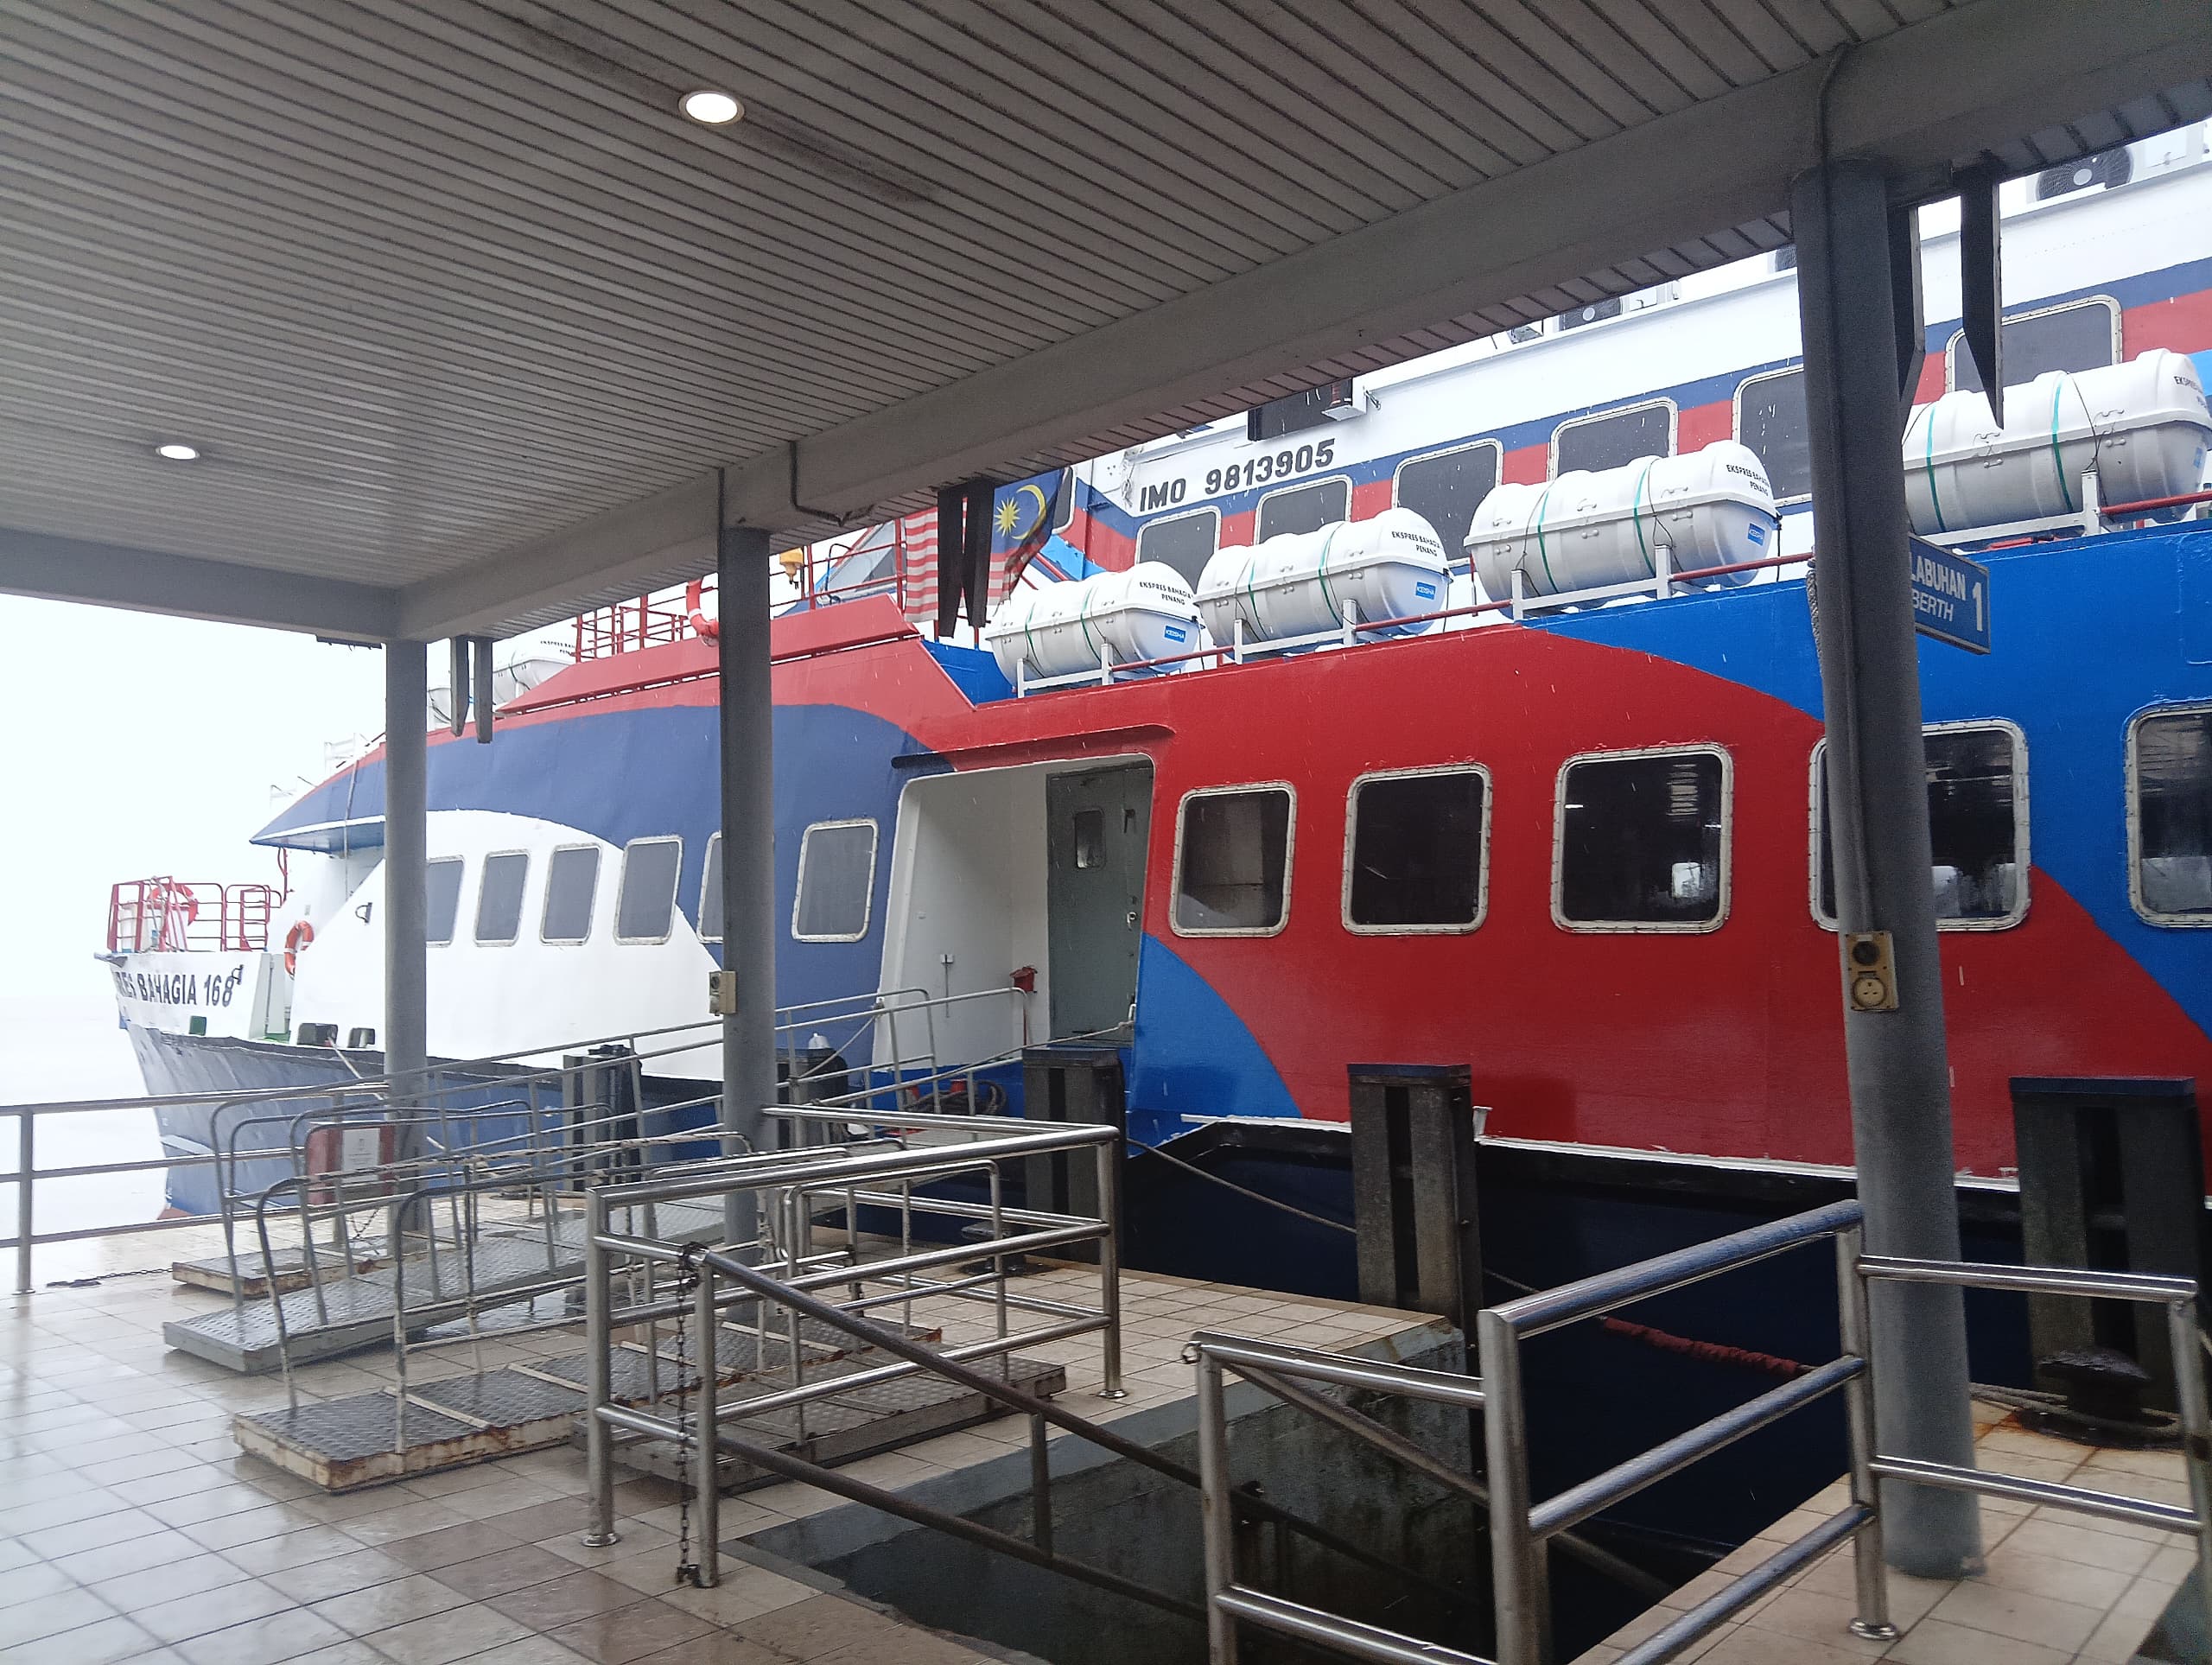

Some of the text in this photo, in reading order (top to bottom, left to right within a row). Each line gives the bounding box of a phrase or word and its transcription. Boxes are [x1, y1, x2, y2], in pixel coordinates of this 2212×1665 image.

[1139, 438, 1336, 512] IMO 9813905
[1391, 531, 1419, 542] EKSPRES
[1139, 581, 1166, 592] EKSPRES
[1160, 593, 1185, 606] PENANG
[1911, 588, 1954, 622] BERTH
[1972, 581, 1983, 632] 1
[137, 973, 197, 1006] BAHAGIA
[204, 974, 235, 1008] 168
